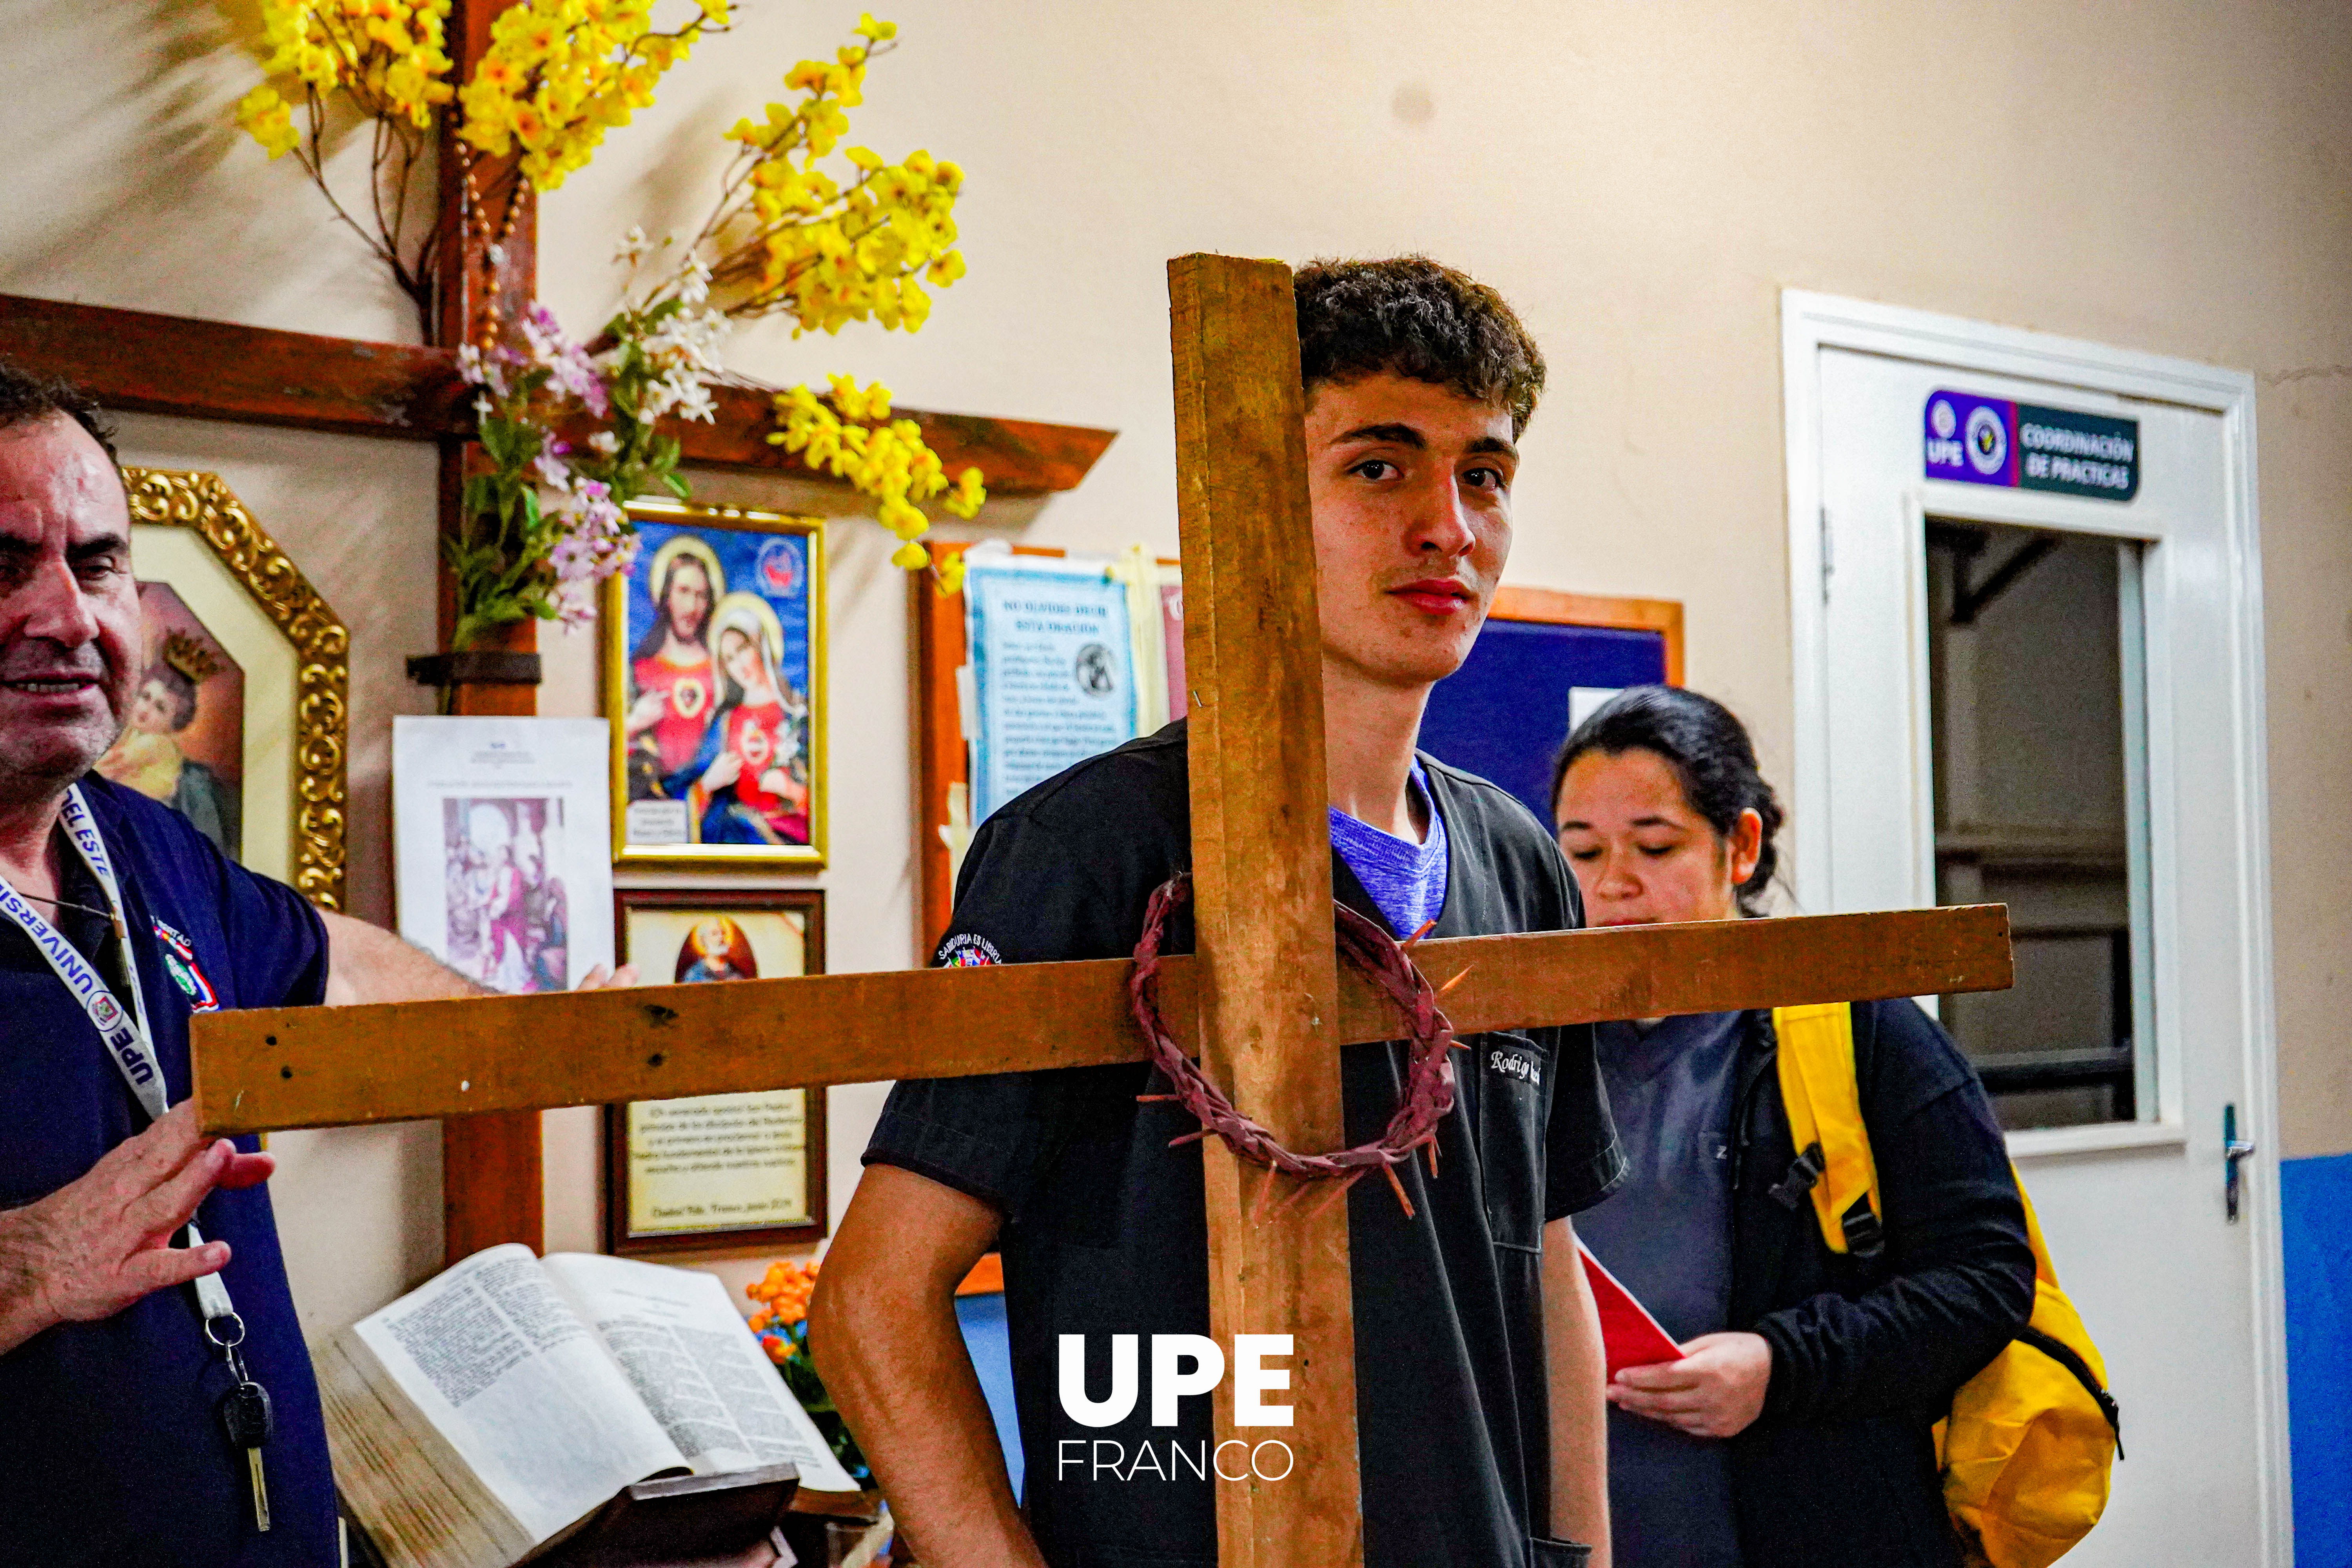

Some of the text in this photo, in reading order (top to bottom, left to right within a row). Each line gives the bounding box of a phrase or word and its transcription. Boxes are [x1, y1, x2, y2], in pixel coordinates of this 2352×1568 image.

[1927, 441, 1964, 466] UPE
[2026, 452, 2049, 478] DE
[938, 933, 972, 960] SABIDURIA
[973, 934, 982, 946] ES
[110, 1027, 153, 1085] UPE
